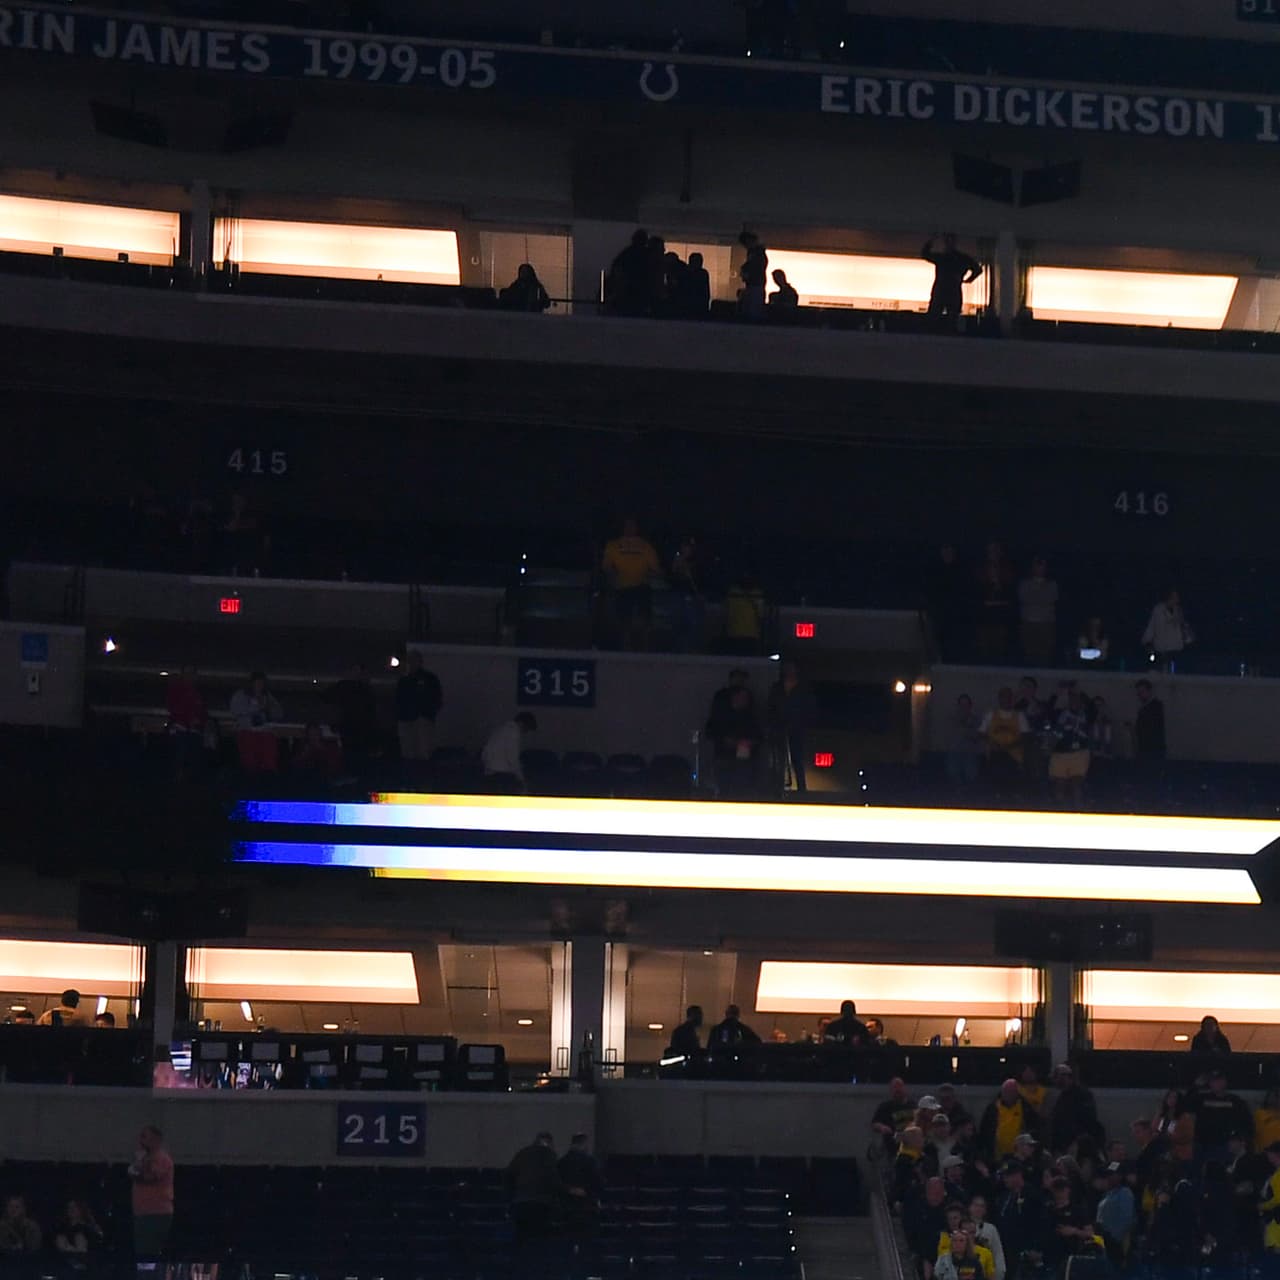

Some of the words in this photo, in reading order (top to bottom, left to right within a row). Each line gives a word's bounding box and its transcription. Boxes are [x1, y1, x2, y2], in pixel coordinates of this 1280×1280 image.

[92, 20, 270, 74] JAMES
[304, 38, 497, 89] 1999-05
[820, 75, 935, 120] ERIC
[953, 83, 1225, 138] DICKERSON
[227, 448, 289, 476] 415
[1113, 491, 1170, 518] 416
[523, 668, 590, 698] 315
[343, 1115, 418, 1145] 215
